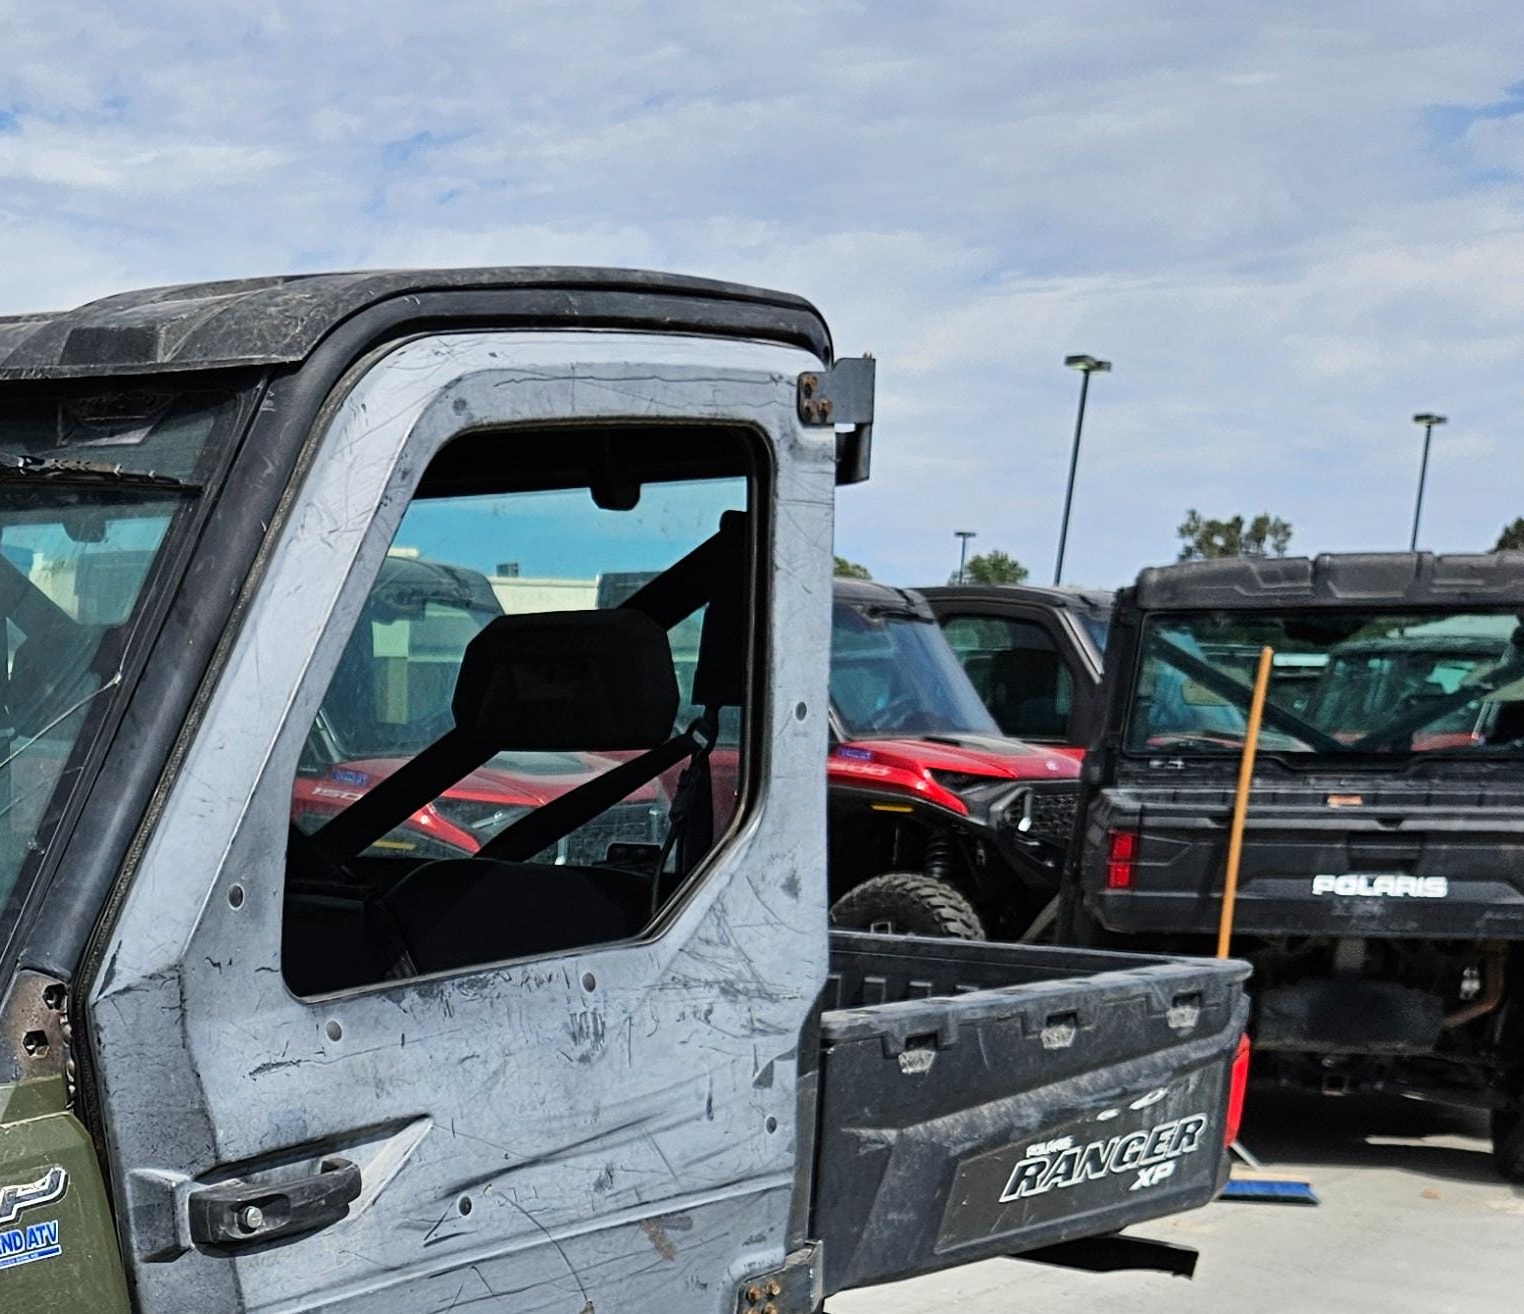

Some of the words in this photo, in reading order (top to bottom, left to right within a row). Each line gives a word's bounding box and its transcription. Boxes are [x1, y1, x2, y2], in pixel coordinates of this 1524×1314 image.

[1312, 874, 1448, 898] POLARIS
[999, 1112, 1208, 1203] RANGER
[1128, 1160, 1176, 1191] XP
[26, 1220, 58, 1249] ATV
